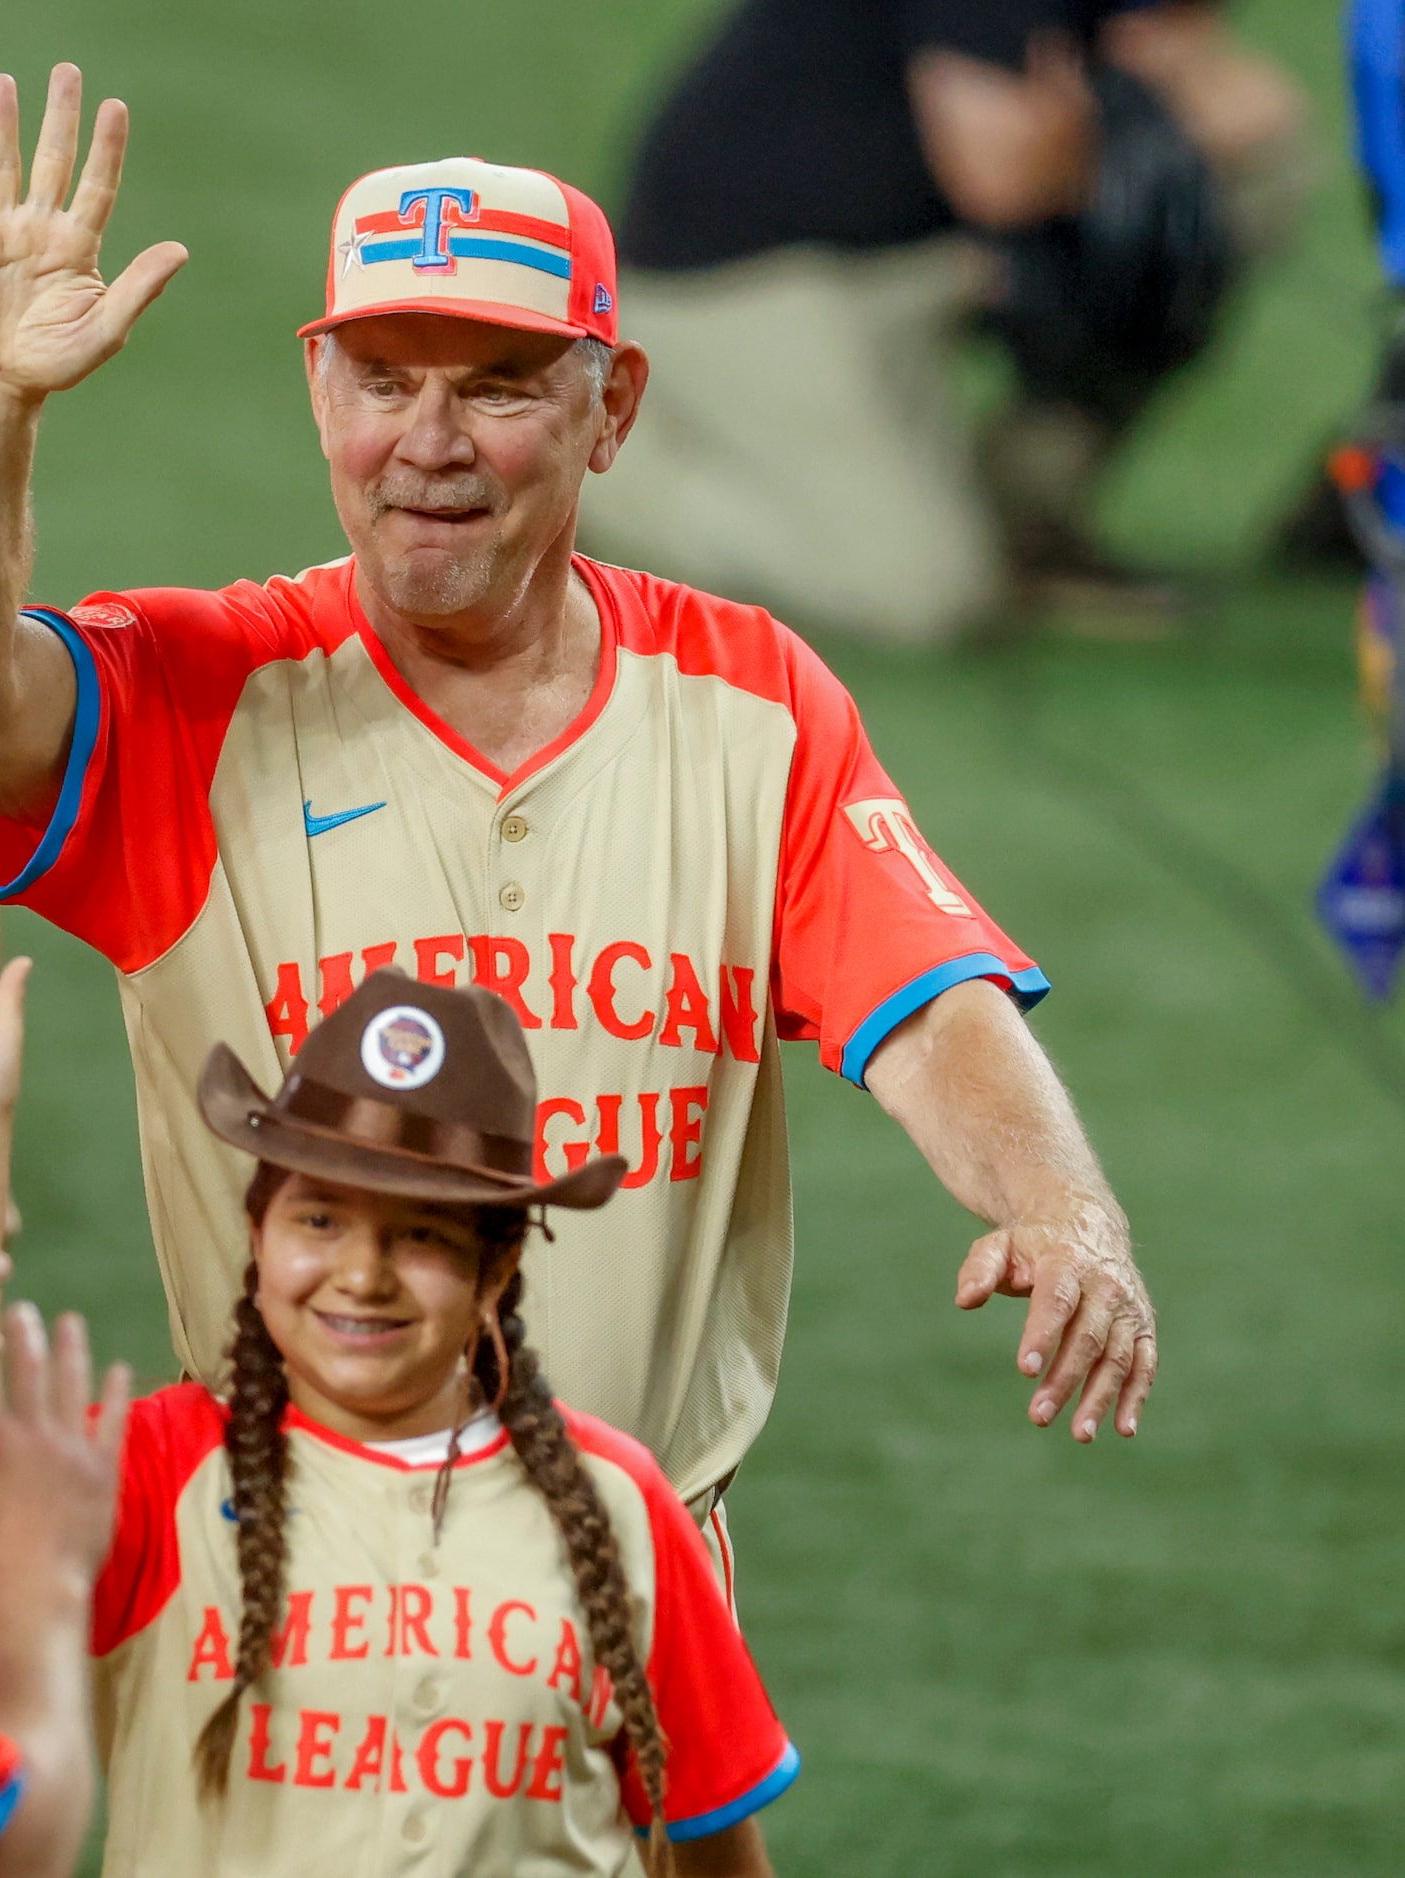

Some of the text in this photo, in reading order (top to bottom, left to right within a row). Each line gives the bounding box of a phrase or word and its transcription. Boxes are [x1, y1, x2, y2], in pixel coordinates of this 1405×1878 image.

[398, 187, 480, 276] T
[532, 1085, 709, 1189] GUE
[247, 1704, 570, 1804] LEAGUE
